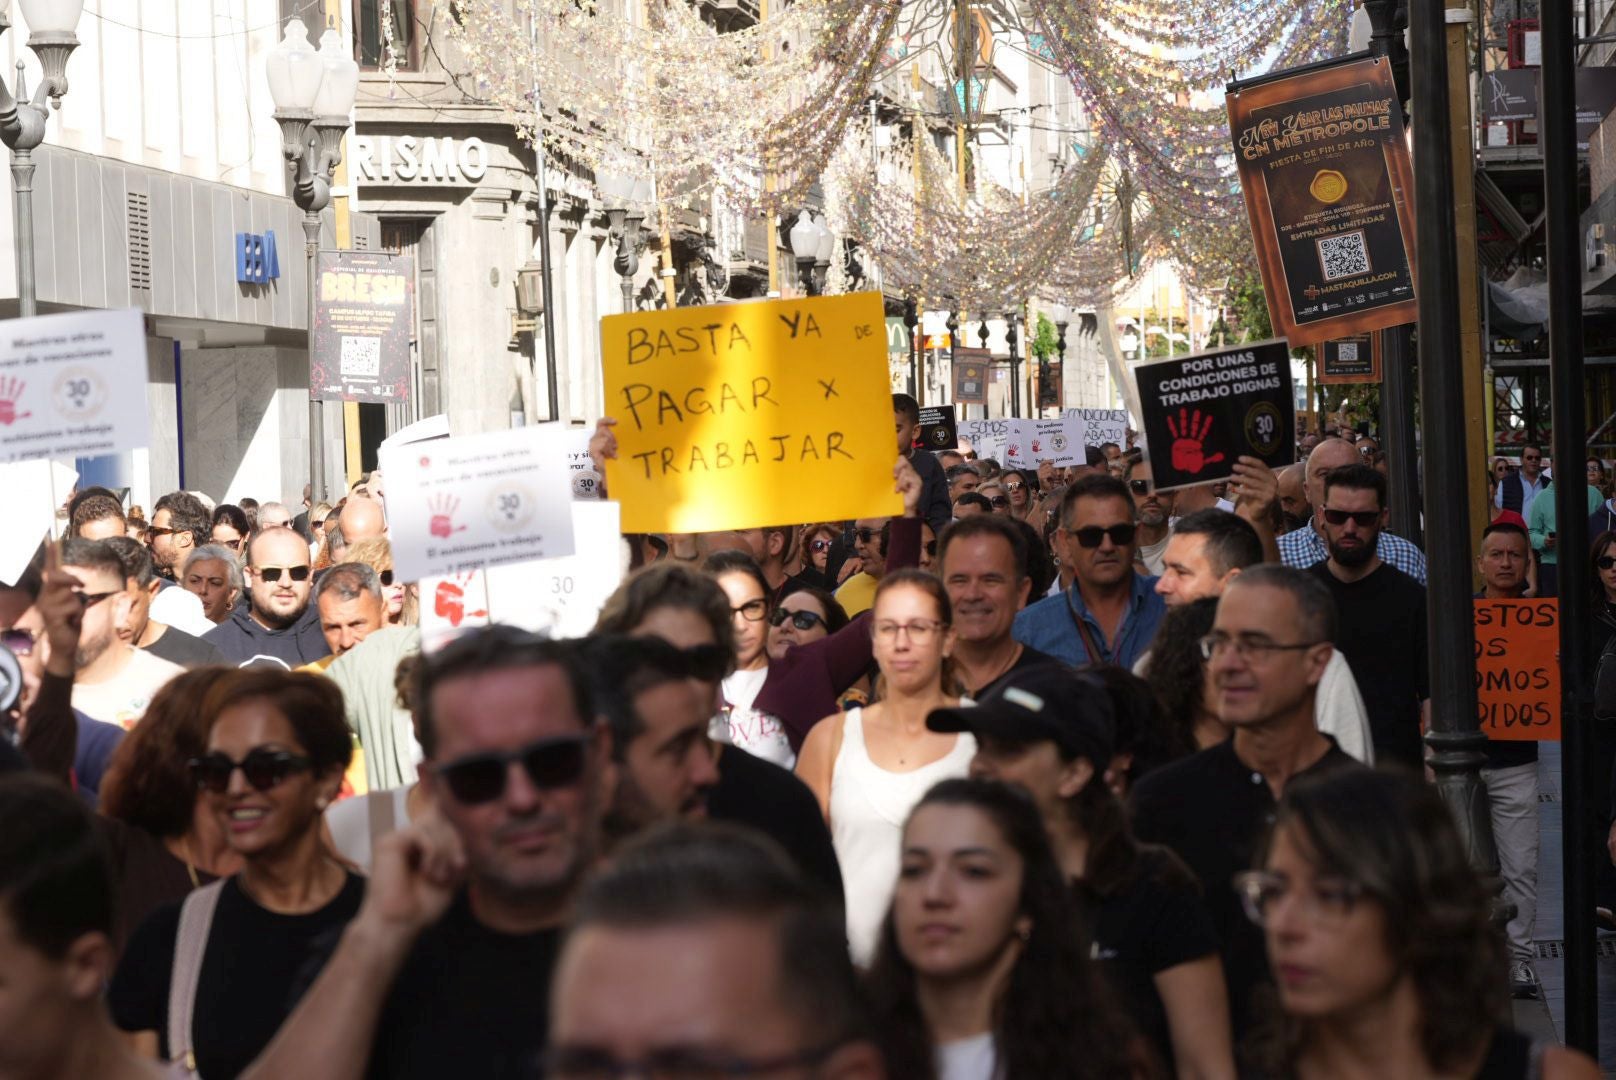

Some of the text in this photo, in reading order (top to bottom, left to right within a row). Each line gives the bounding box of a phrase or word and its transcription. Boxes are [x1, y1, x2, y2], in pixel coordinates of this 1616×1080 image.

[1322, 106, 1344, 123] LAS
[1273, 115, 1391, 151] METROPOLE
[1269, 153, 1302, 169] FIESTA
[1303, 149, 1318, 159] DE
[1319, 145, 1336, 155] FIN
[1337, 142, 1351, 151] DE
[1353, 138, 1375, 149] AÑO
[1290, 213, 1386, 241] ENTRADAS LIMITADAS
[627, 310, 873, 365] BASTA YA DE
[1181, 351, 1256, 374] POR UNAS
[67, 379, 91, 398] 30
[1158, 363, 1278, 393] CONDICIONES DE
[1158, 376, 1281, 408] TRABAJO DIGNAS
[620, 377, 779, 432] PAGAR
[936, 430, 945, 438] 30
[970, 420, 1009, 434] SOMOS
[1088, 421, 1100, 430] DE
[1255, 414, 1274, 435] 30
[631, 431, 855, 480] TRABAJAR
[580, 479, 594, 488] 30
[498, 493, 520, 512] 30
[551, 576, 574, 594] 30
[1474, 603, 1557, 627] STOS
